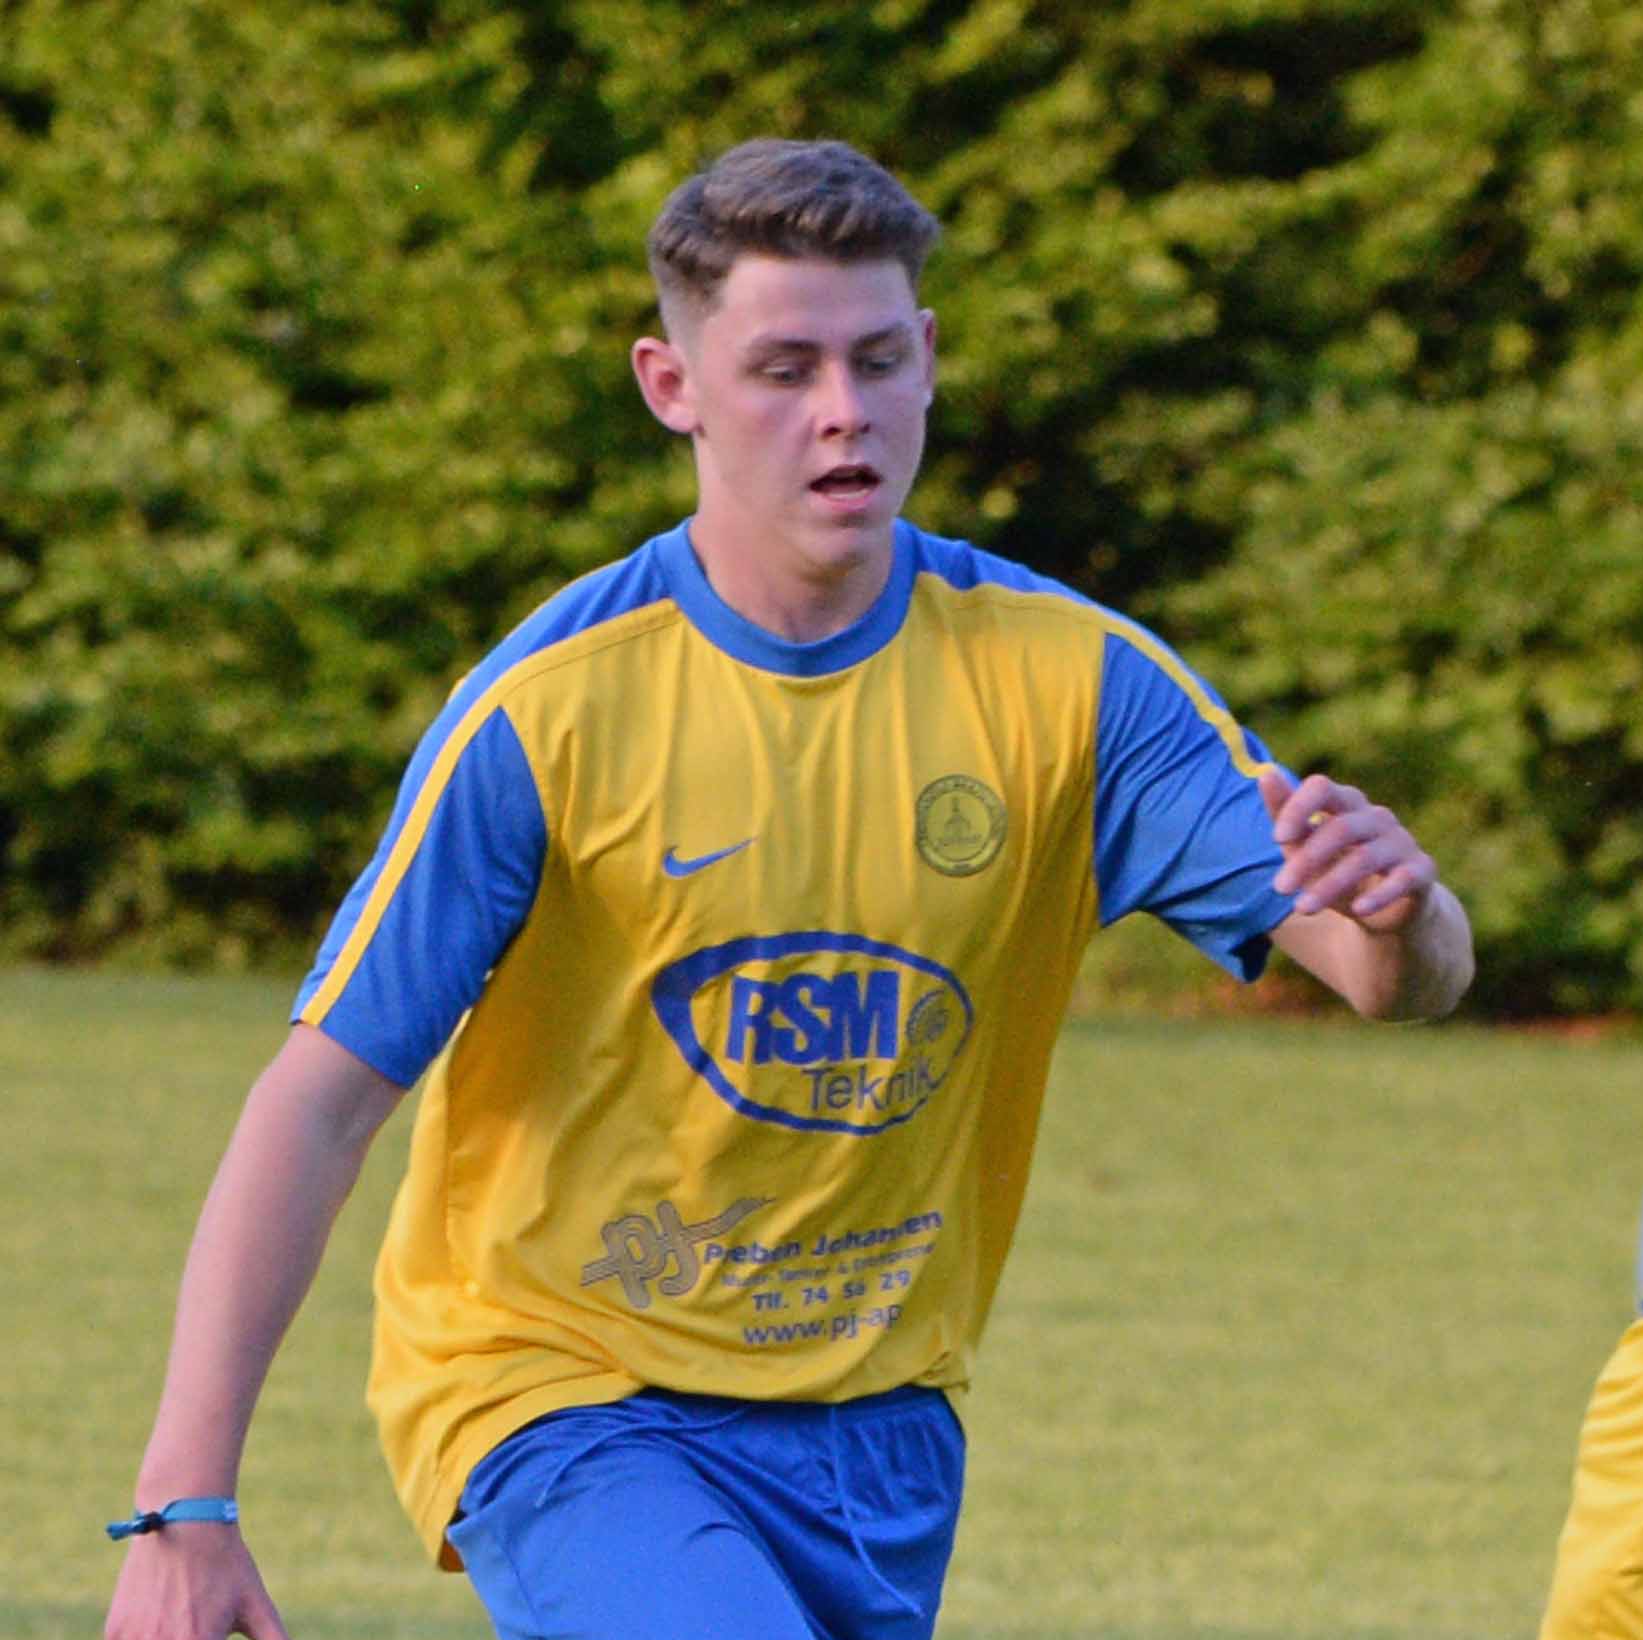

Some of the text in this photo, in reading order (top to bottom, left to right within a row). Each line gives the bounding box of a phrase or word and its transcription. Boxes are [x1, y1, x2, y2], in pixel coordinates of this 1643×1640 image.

[725, 970, 900, 1066] RSM
[703, 1240, 801, 1265] Peben
[811, 1211, 943, 1257] Johanen
